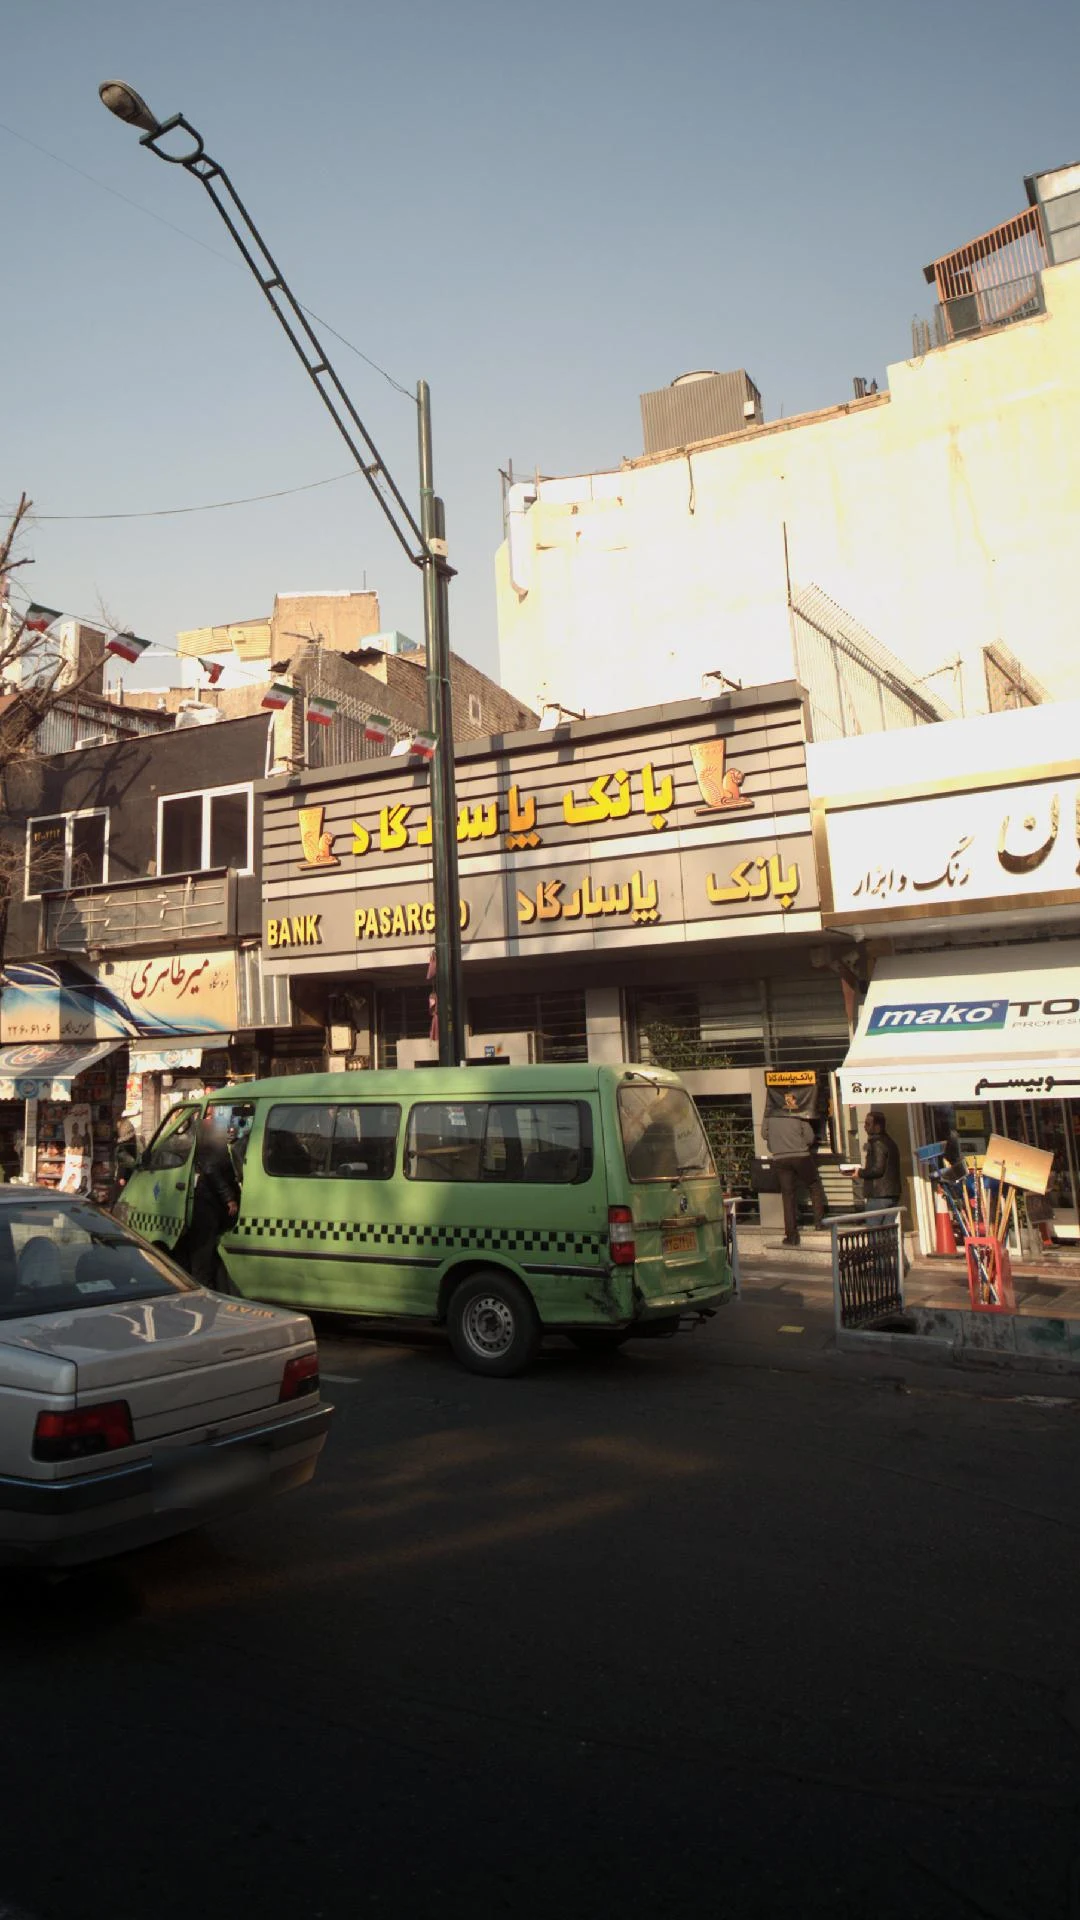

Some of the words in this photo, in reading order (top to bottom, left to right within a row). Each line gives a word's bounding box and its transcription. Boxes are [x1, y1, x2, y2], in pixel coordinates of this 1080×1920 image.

[352, 784, 541, 854] پاسرگاد
[563, 762, 673, 830] بانک
[706, 854, 798, 908] بانک
[912, 836, 975, 890] رنگ
[267, 915, 321, 947] BANK
[354, 899, 468, 938] PASARGD
[518, 870, 658, 922] پاسارگاد
[878, 1005, 993, 1028] mako
